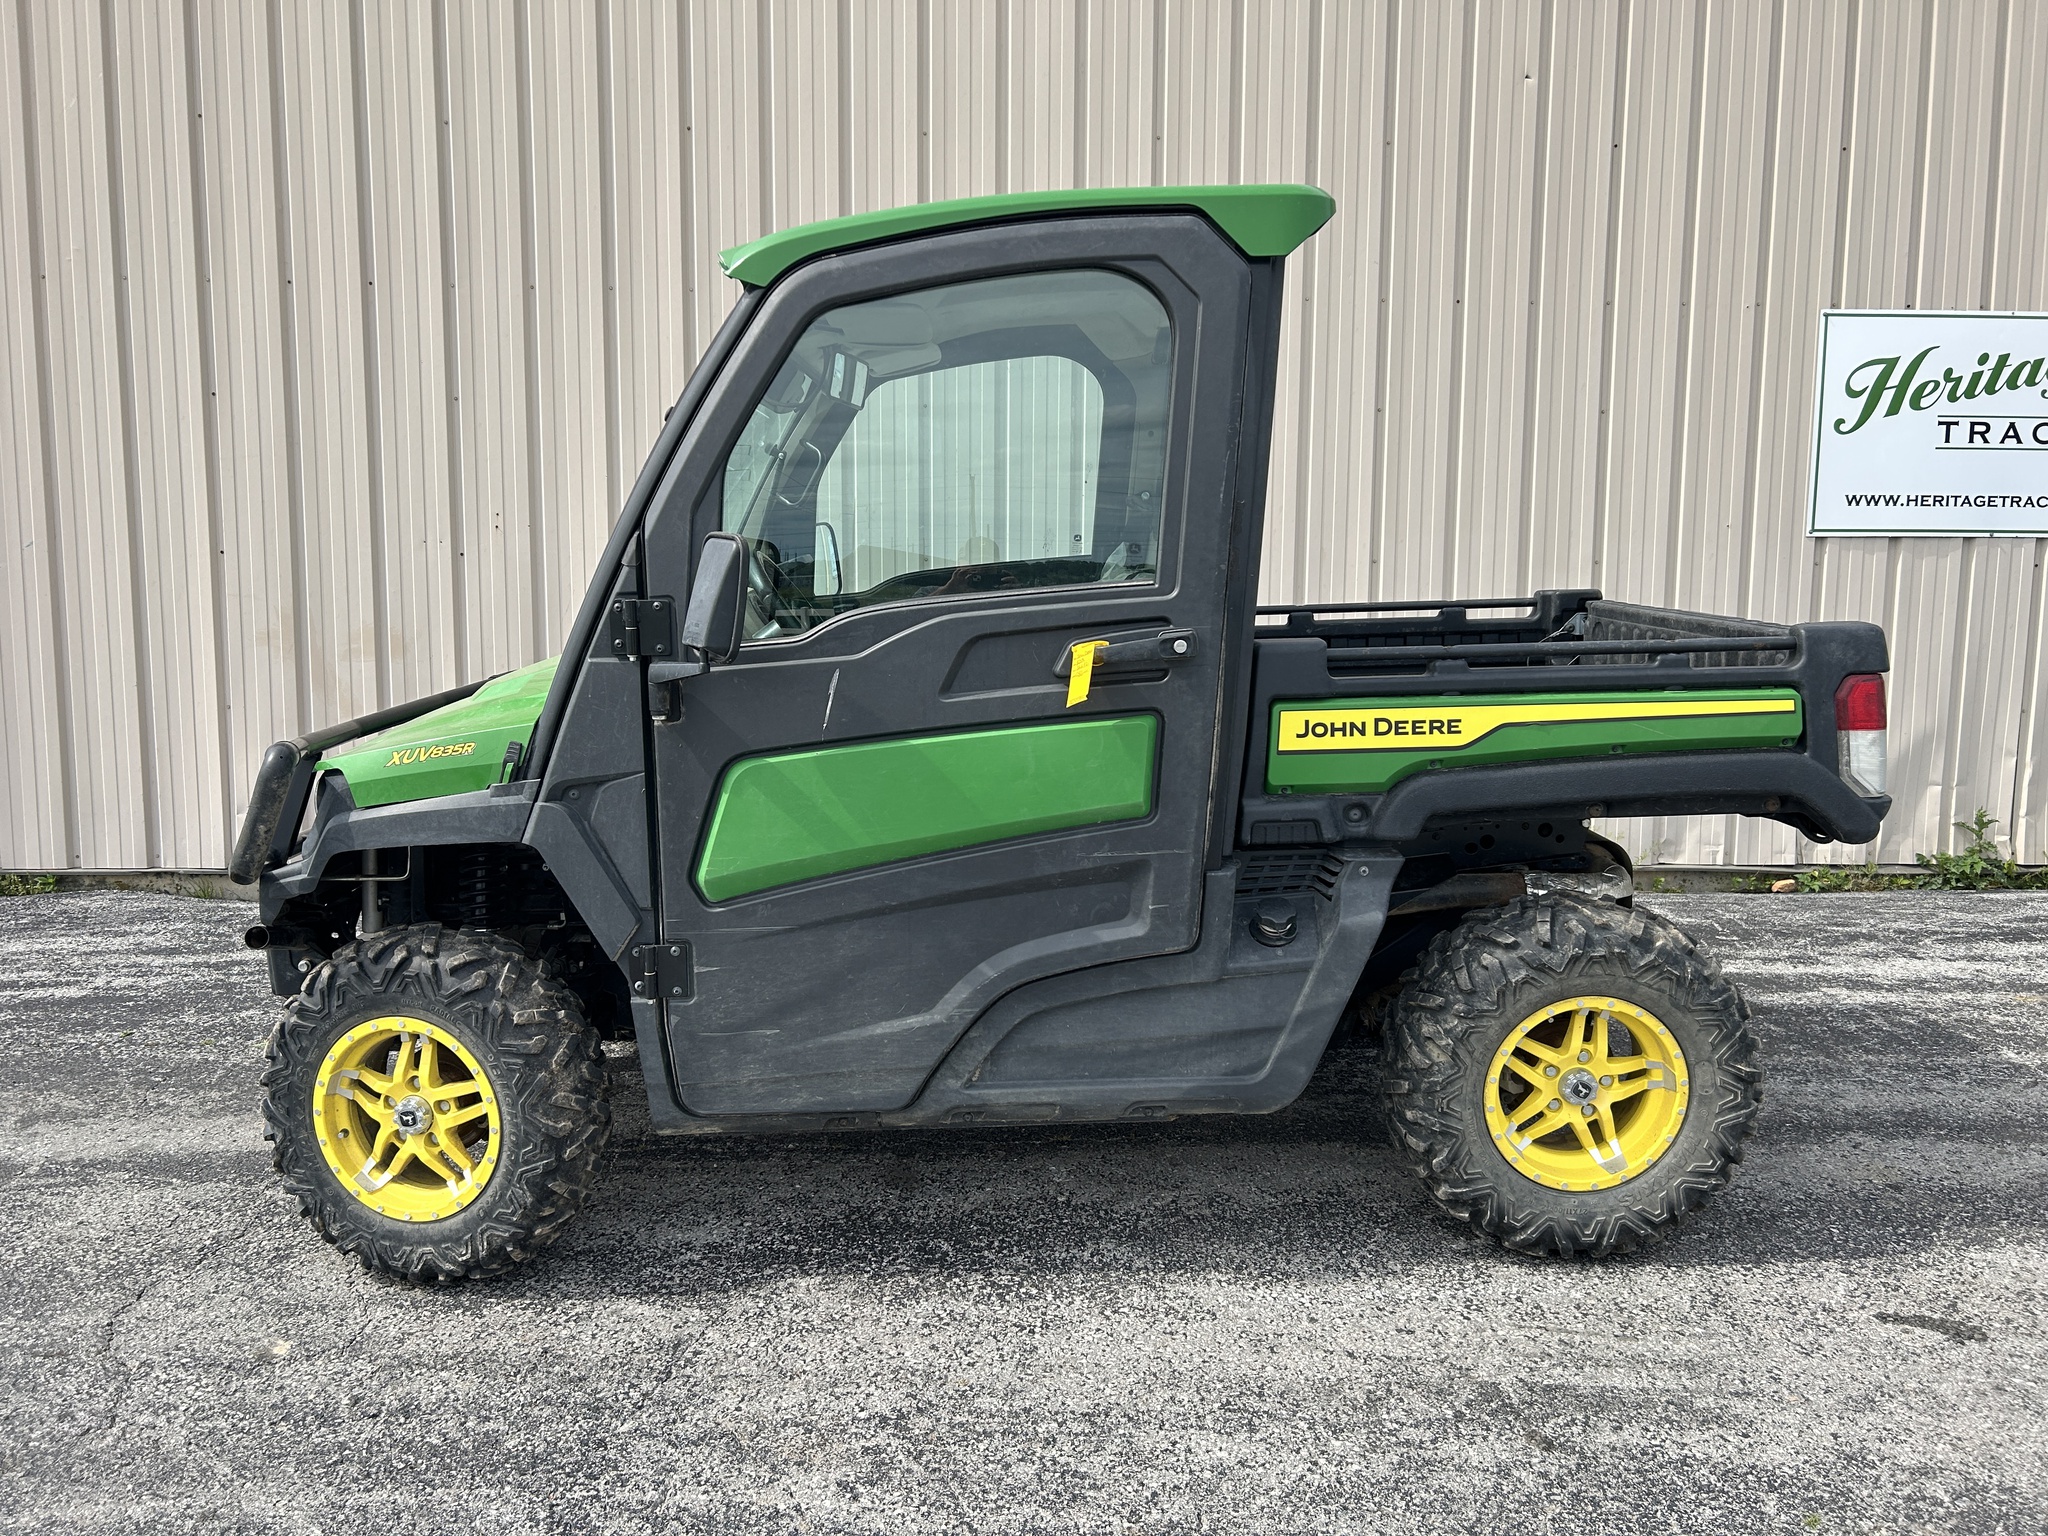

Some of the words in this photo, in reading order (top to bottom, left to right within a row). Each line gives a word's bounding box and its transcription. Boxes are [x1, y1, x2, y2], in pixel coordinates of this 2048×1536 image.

[1833, 346, 2048, 435] Herita
[1845, 495, 2048, 508] WWW.HERITAGETRAC
[1296, 719, 1366, 738] JOHN
[1374, 717, 1462, 737] DEERE
[384, 742, 476, 768] XUV835R
[1618, 1131, 1702, 1208] MAXXIS
